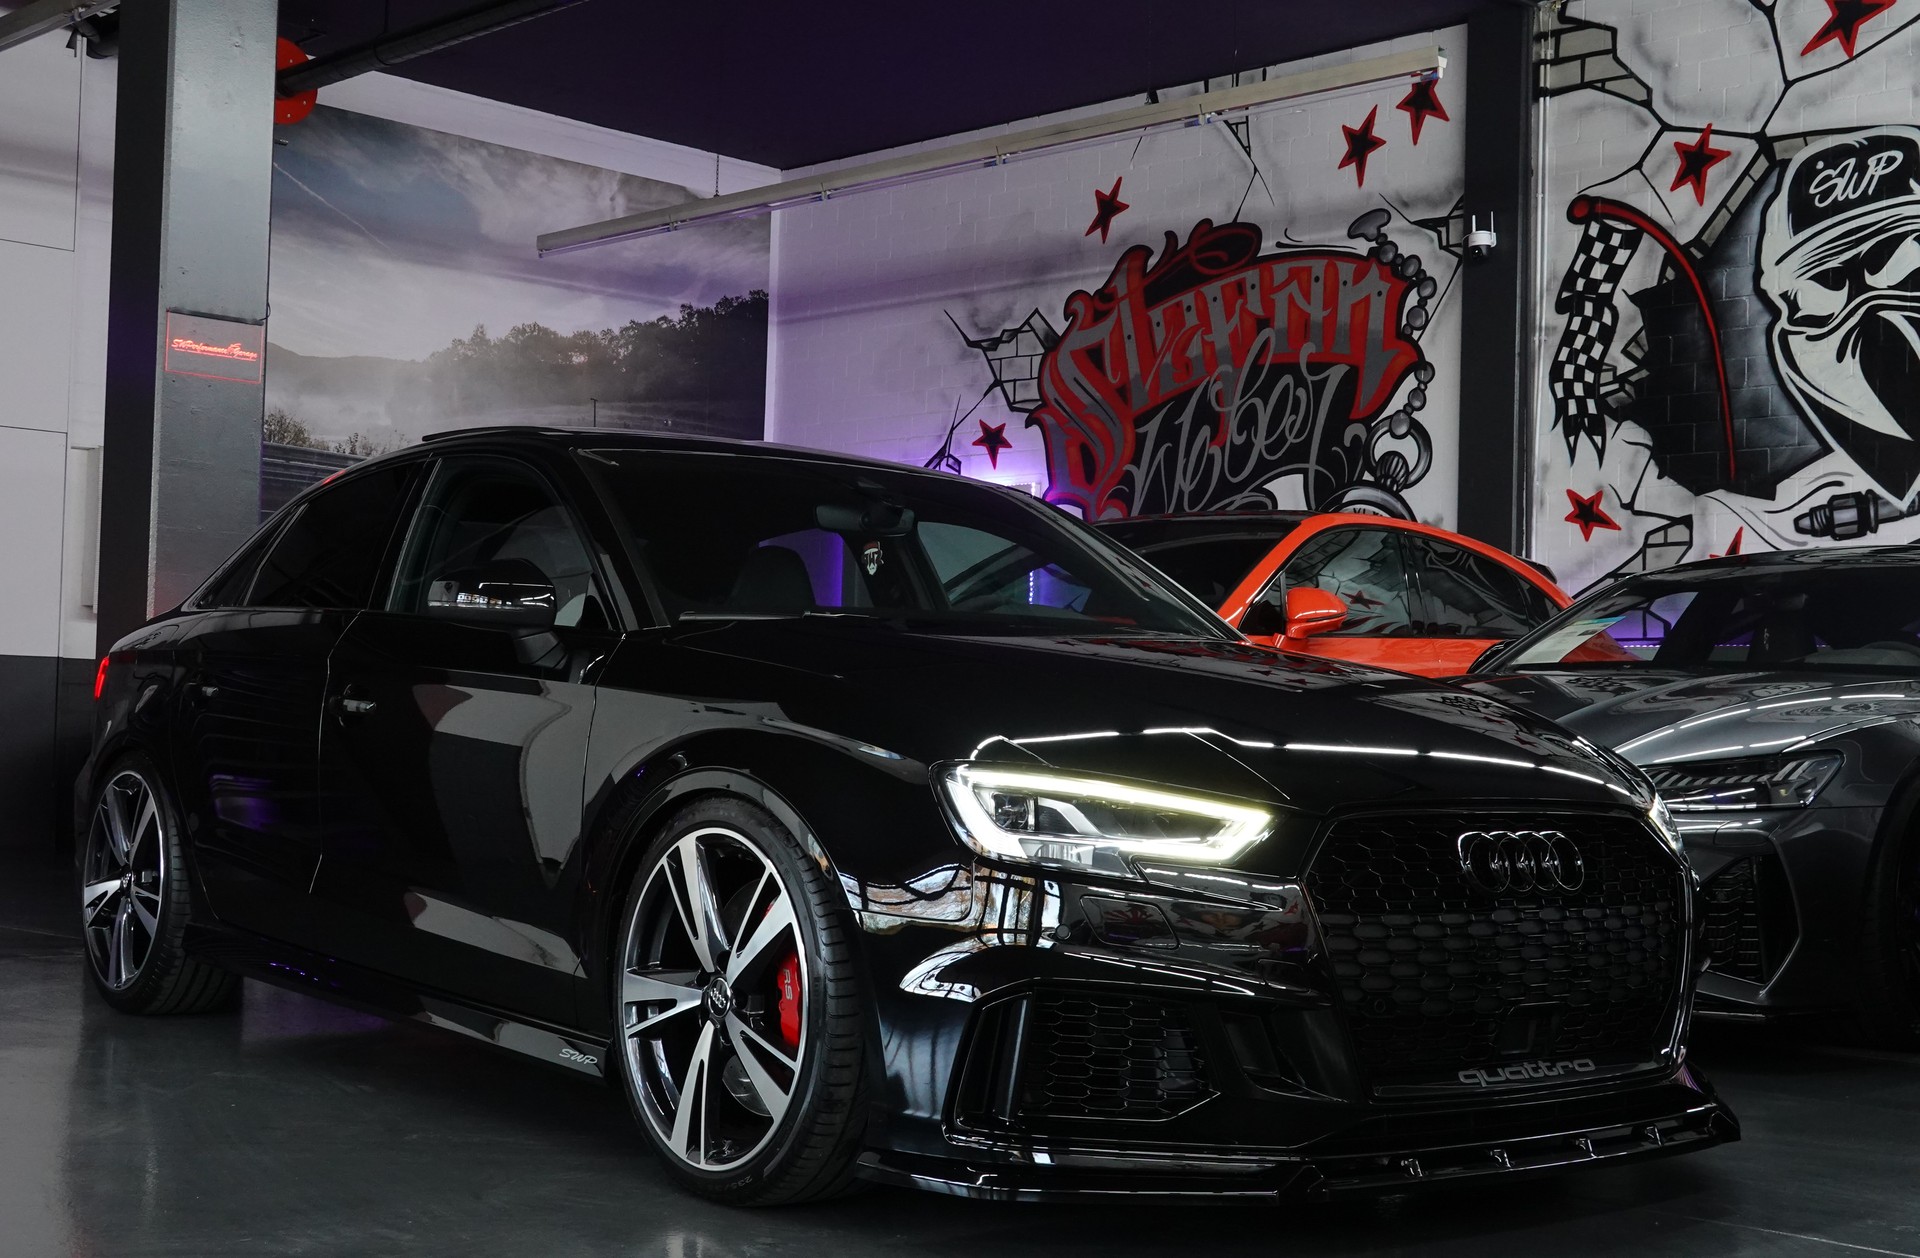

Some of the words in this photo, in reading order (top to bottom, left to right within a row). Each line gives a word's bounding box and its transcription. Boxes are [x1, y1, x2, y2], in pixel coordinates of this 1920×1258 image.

[1808, 150, 1904, 208] SWP
[783, 968, 793, 1001] RS
[558, 1048, 598, 1065] SWP
[1457, 1058, 1596, 1088] quattro
